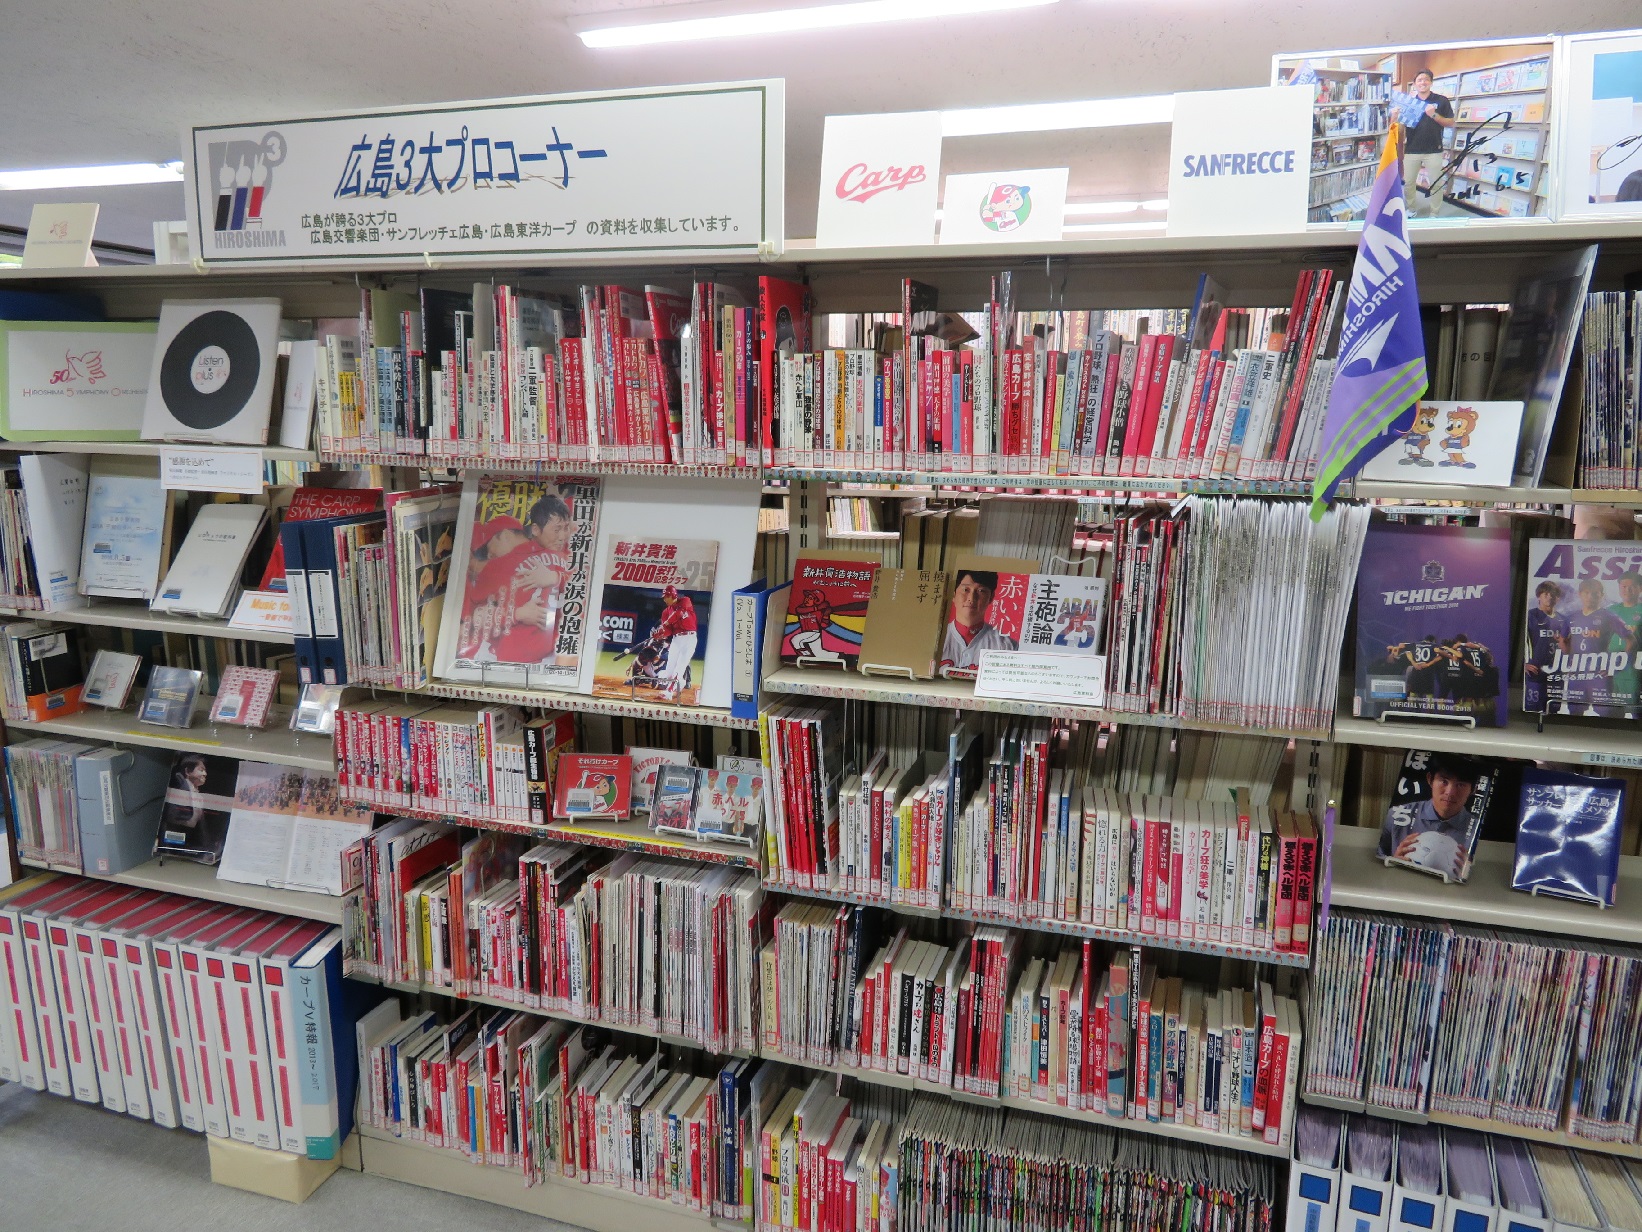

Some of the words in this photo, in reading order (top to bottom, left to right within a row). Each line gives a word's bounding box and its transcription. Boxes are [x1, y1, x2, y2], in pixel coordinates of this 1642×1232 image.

[334, 125, 608, 199] 広島3大プロコーナー
[1183, 150, 1296, 178] SANFRECCE
[835, 162, 928, 205] Carp
[301, 212, 398, 228] 広島が誇る3大プロ
[586, 214, 741, 236] の資料を収集しています。
[214, 230, 287, 249] HIROSHIMA
[1093, 333, 1104, 370] プロ野球
[1011, 353, 1021, 401] 広島カープ
[1262, 354, 1275, 381] 二軍史
[529, 366, 538, 406] 二軍監督
[925, 361, 933, 407] マエケン
[717, 391, 727, 429] カープ検定
[294, 493, 317, 507] THE
[321, 494, 361, 507] CARP
[613, 541, 678, 560] 新井貴浩
[1577, 545, 1612, 554] Sanfrecce
[555, 485, 600, 655] 黒田が新井が涙の抱擁
[610, 564, 655, 583] 2000
[656, 565, 678, 576] 安打
[802, 565, 872, 582] 新井貴浩物語
[994, 575, 1024, 638] 赤い心
[1380, 584, 1490, 606] ICHIGAN
[1030, 579, 1061, 646] 主砲論
[1415, 646, 1431, 662] 30
[1470, 651, 1481, 668] 15
[1542, 649, 1628, 678] Jump
[1389, 701, 1417, 709] OFFICIAL
[1418, 702, 1435, 710] YEAR
[1438, 703, 1454, 711] BOOK
[1456, 704, 1472, 712] 2018
[711, 792, 749, 807] 赤ヘル
[1198, 830, 1211, 890] カープ狂の美学
